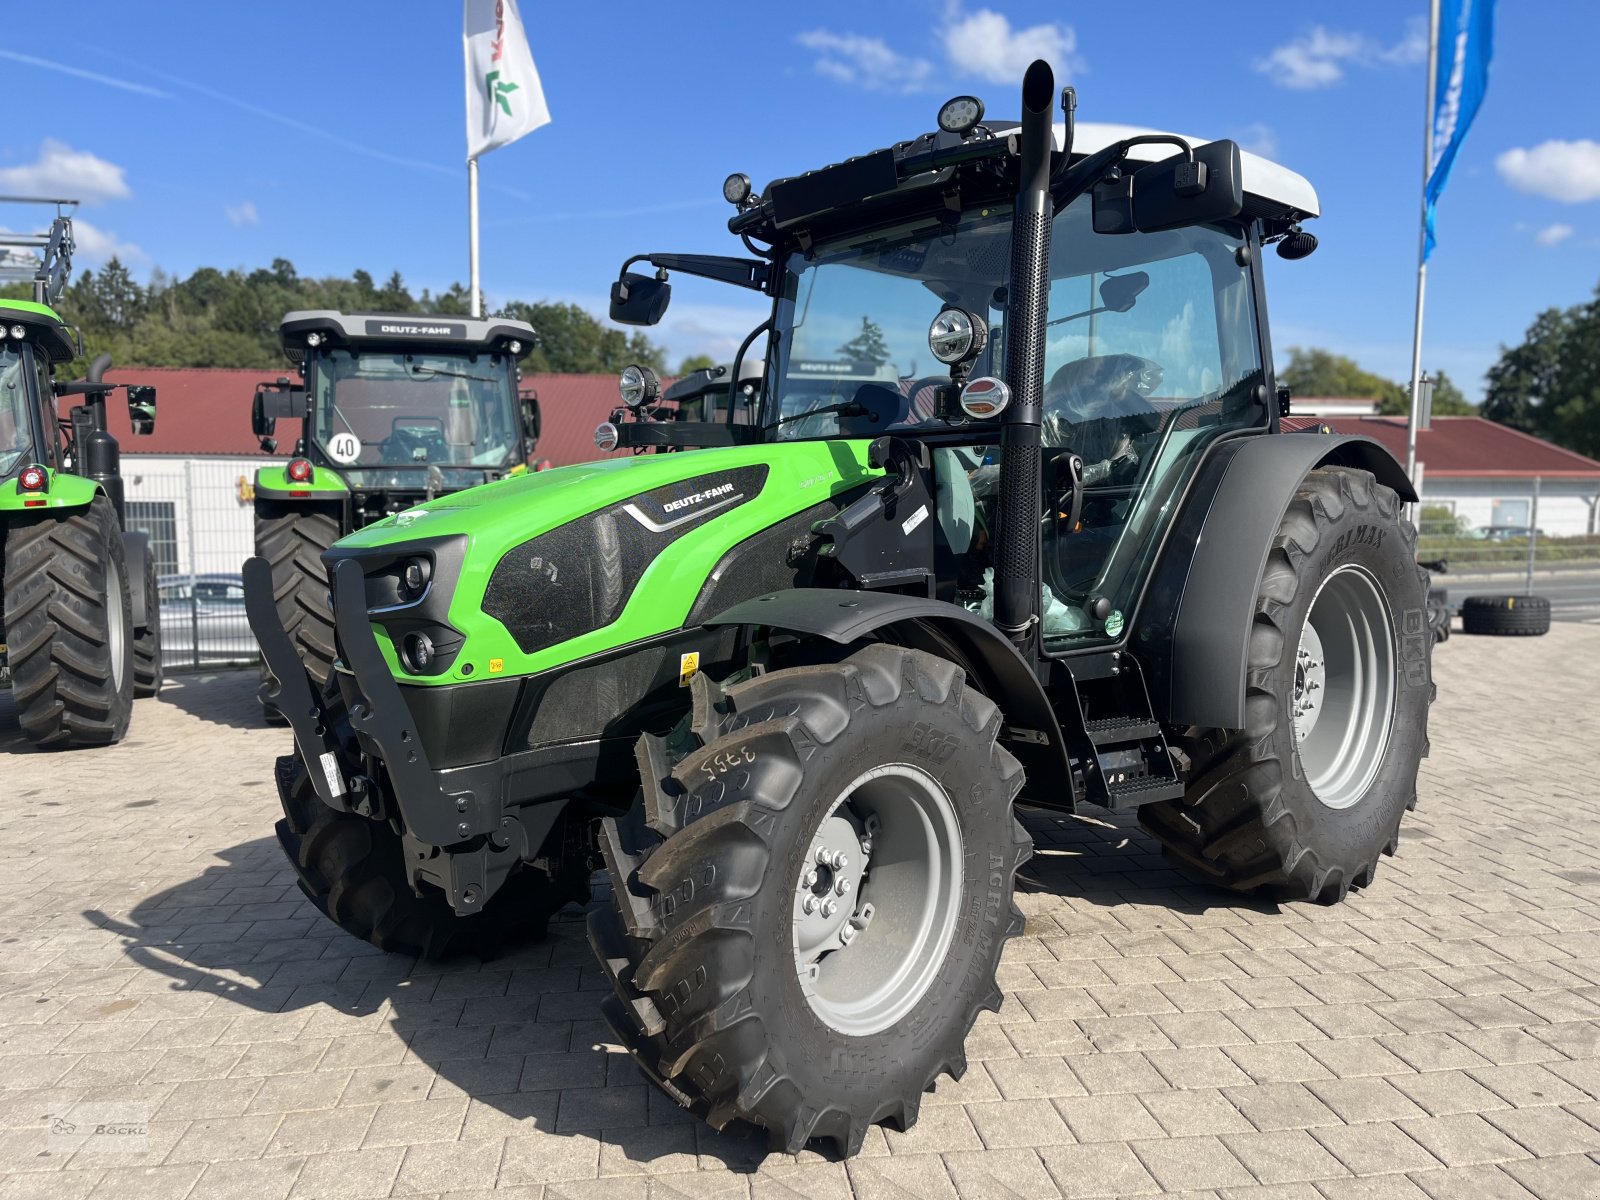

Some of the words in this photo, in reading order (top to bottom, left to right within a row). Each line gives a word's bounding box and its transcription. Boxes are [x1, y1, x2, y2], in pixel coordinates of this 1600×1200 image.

[381, 325, 451, 335] DEUTZ-FAHR
[336, 438, 355, 457] 40
[662, 483, 735, 513] DEUTZ-FAHR
[700, 746, 756, 782] 3755
